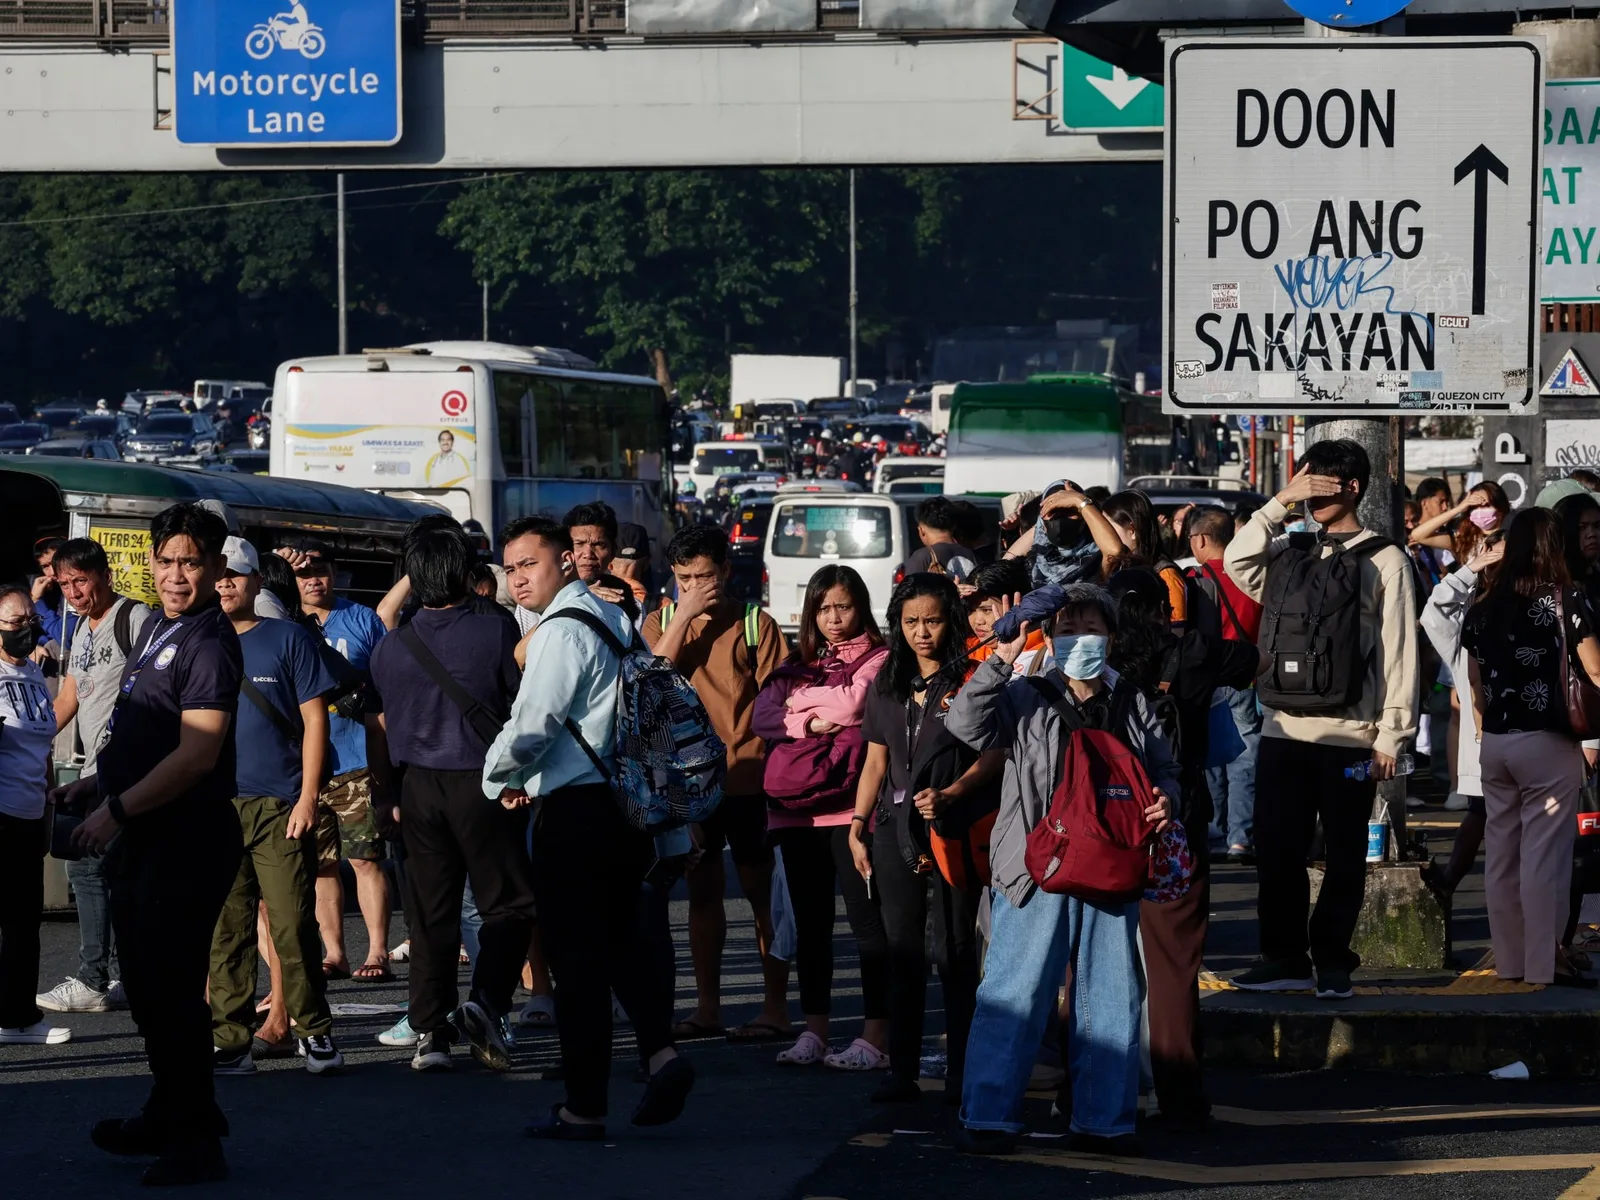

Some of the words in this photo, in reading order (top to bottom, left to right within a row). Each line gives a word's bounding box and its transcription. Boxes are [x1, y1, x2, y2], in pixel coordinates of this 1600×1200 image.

[193, 67, 379, 101] Motorcycle
[247, 108, 325, 134] Lane
[1236, 88, 1396, 149] DOON
[1543, 166, 1583, 205] AT
[1207, 199, 1280, 259] PO
[1308, 198, 1424, 260] ANG
[1545, 226, 1600, 265] AY
[1440, 316, 1469, 328] GCULT
[1195, 312, 1435, 372] SAKAYAN
[1437, 391, 1480, 401] QUEZON
[1483, 391, 1506, 400] CITY
